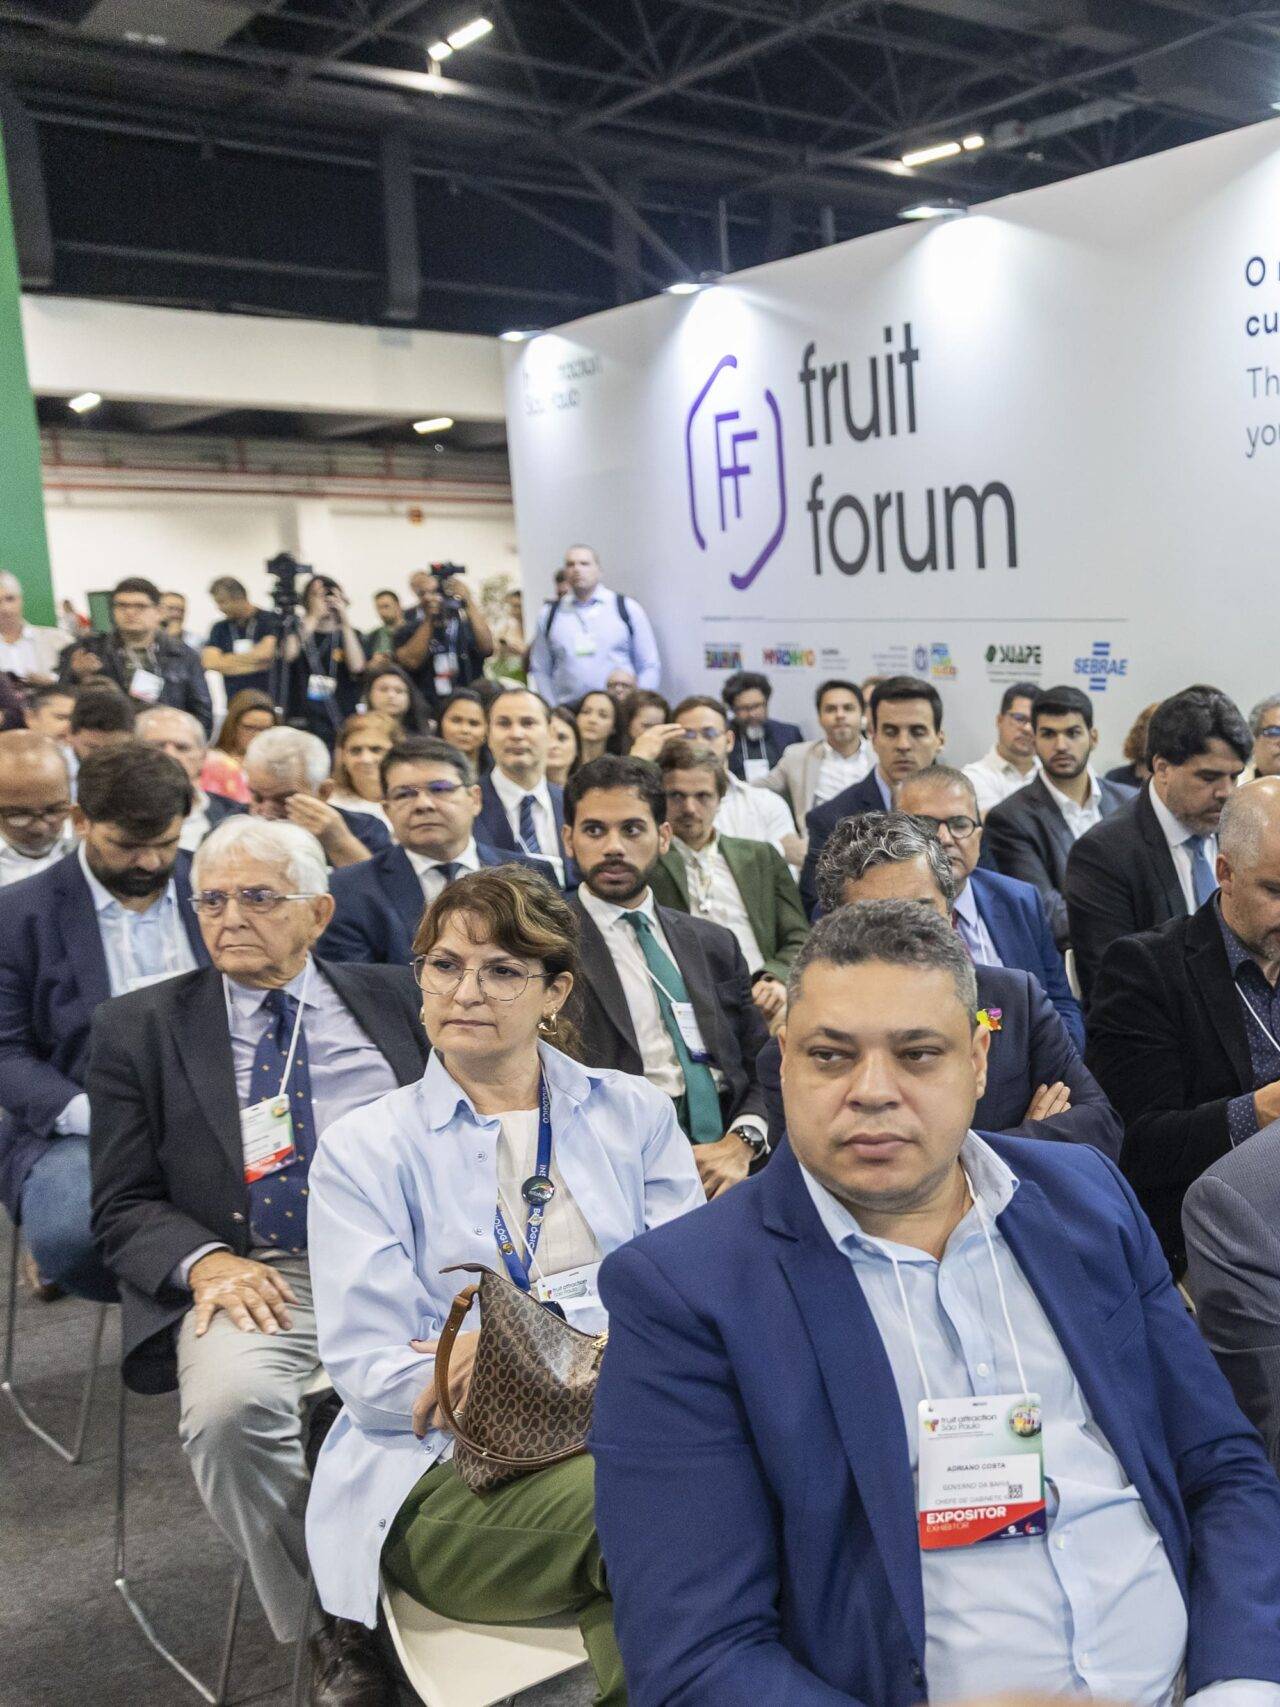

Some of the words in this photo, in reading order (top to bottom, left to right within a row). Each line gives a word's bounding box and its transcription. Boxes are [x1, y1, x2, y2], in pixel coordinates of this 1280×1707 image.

[1245, 256, 1266, 287] O
[798, 322, 919, 448] fruit
[807, 473, 1018, 576] forum
[1073, 658, 1128, 676] SEBRAE
[941, 1415, 957, 1424] fruit
[958, 1414, 997, 1423] attraction
[947, 1464, 979, 1472] ADRIANO
[926, 1506, 1007, 1525] EXPOSITOR
